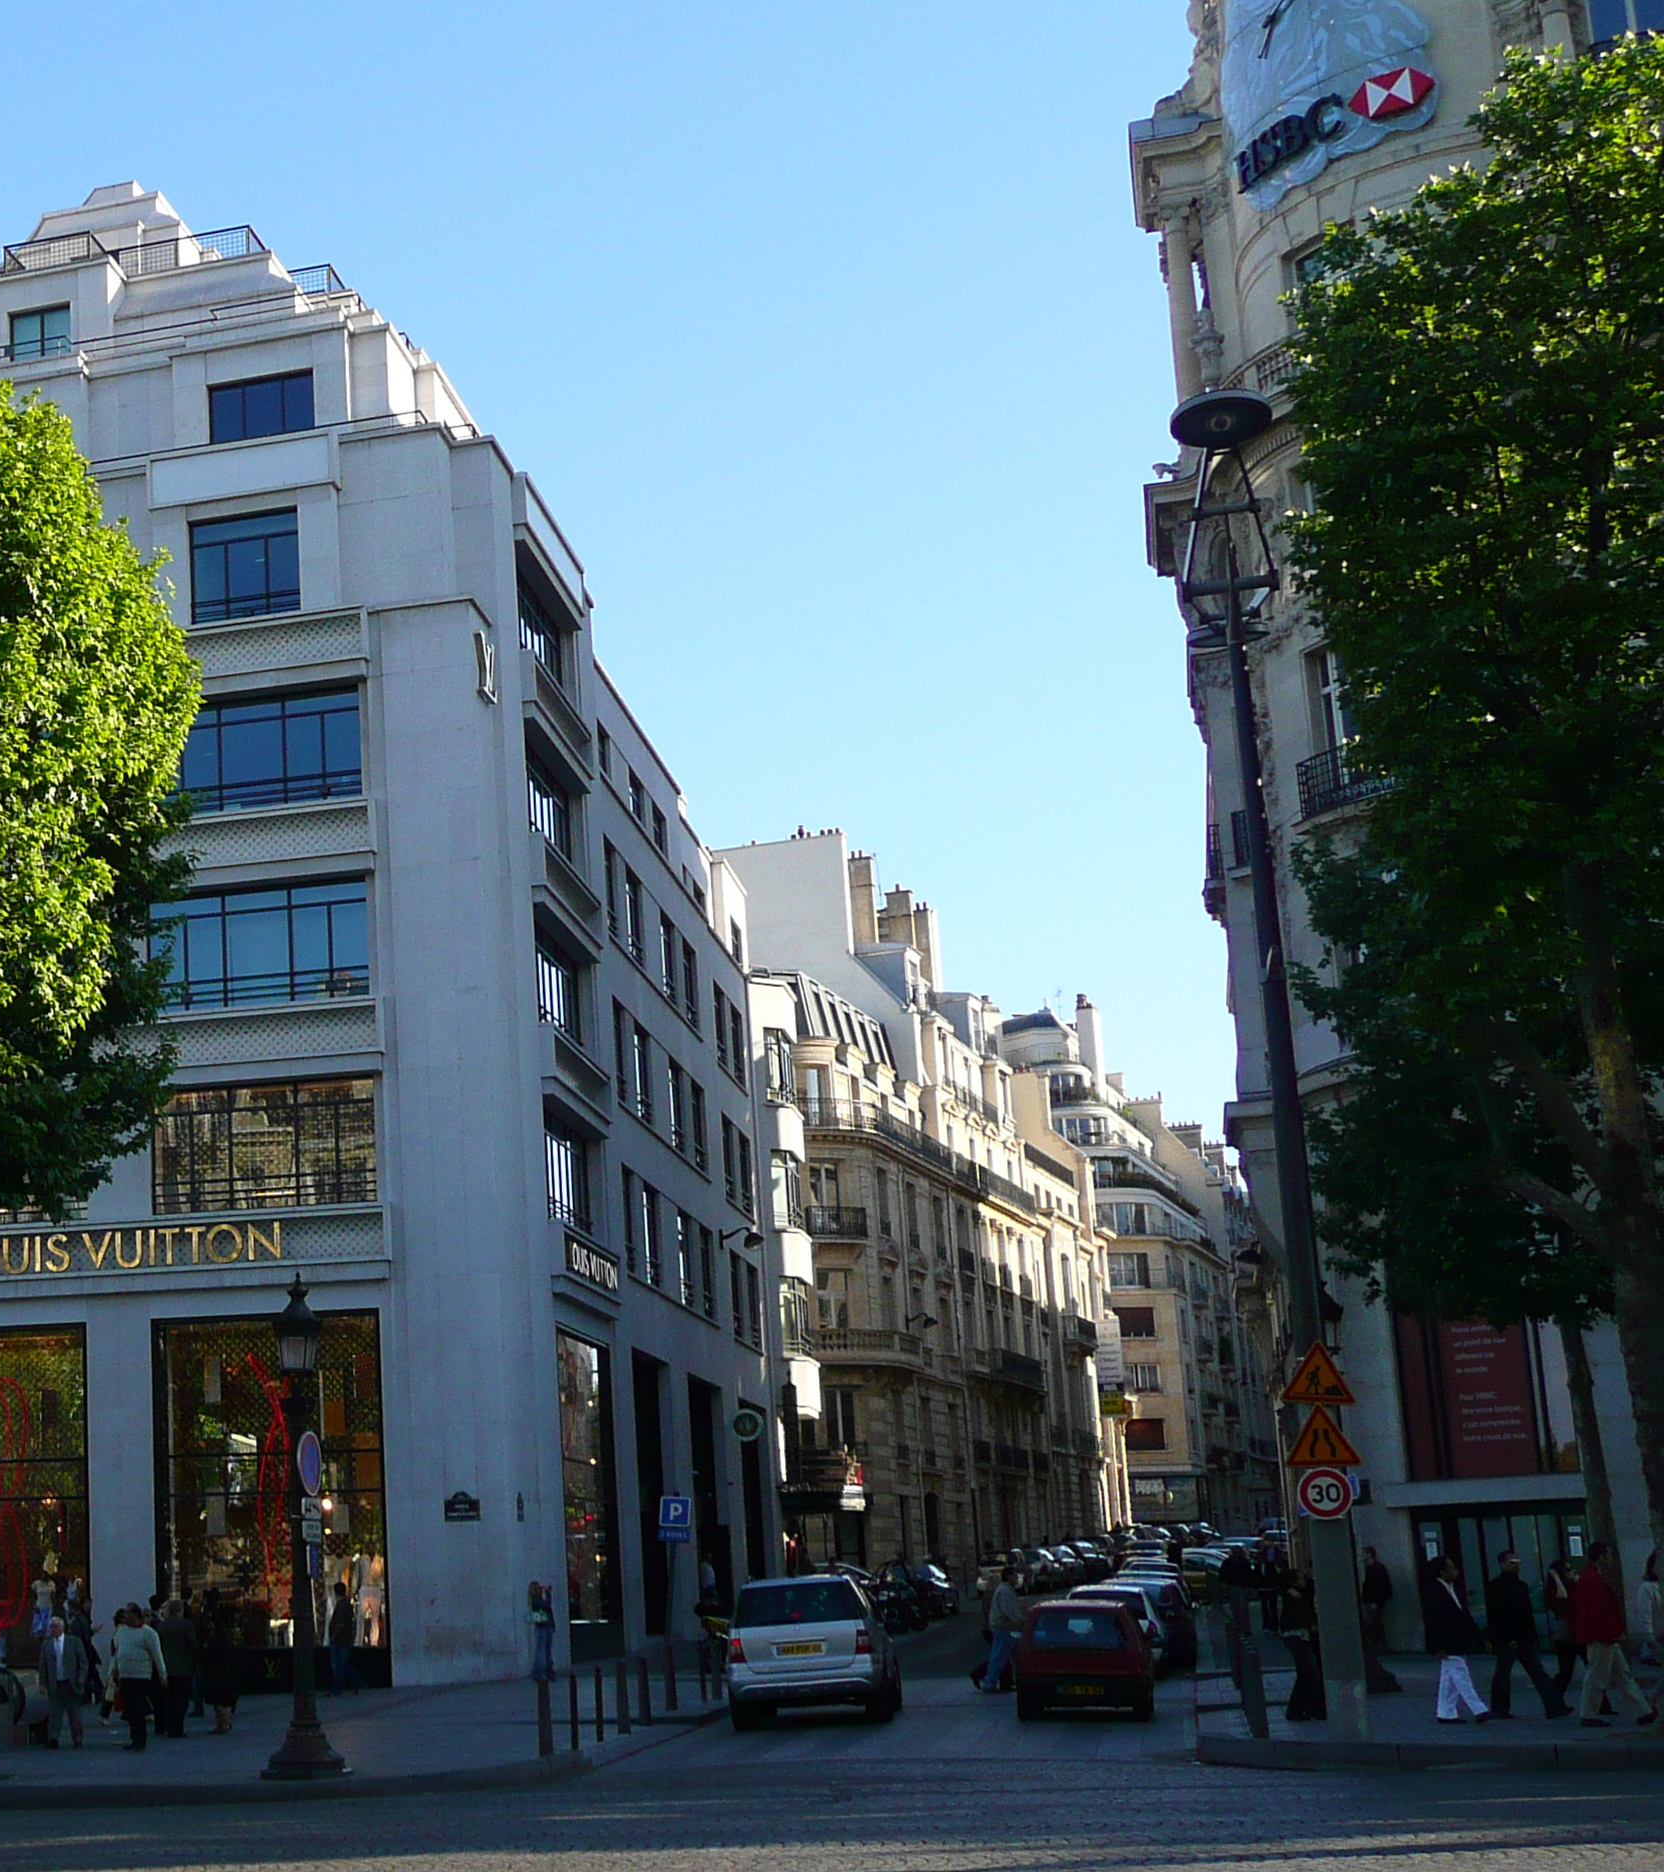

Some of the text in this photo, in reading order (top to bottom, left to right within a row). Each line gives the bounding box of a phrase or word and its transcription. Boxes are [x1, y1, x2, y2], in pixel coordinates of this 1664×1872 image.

[1233, 93, 1346, 194] HSBC
[82, 1220, 282, 1270] VUITTON
[1311, 1483, 1341, 1503] 30
[669, 1502, 683, 1521] P
